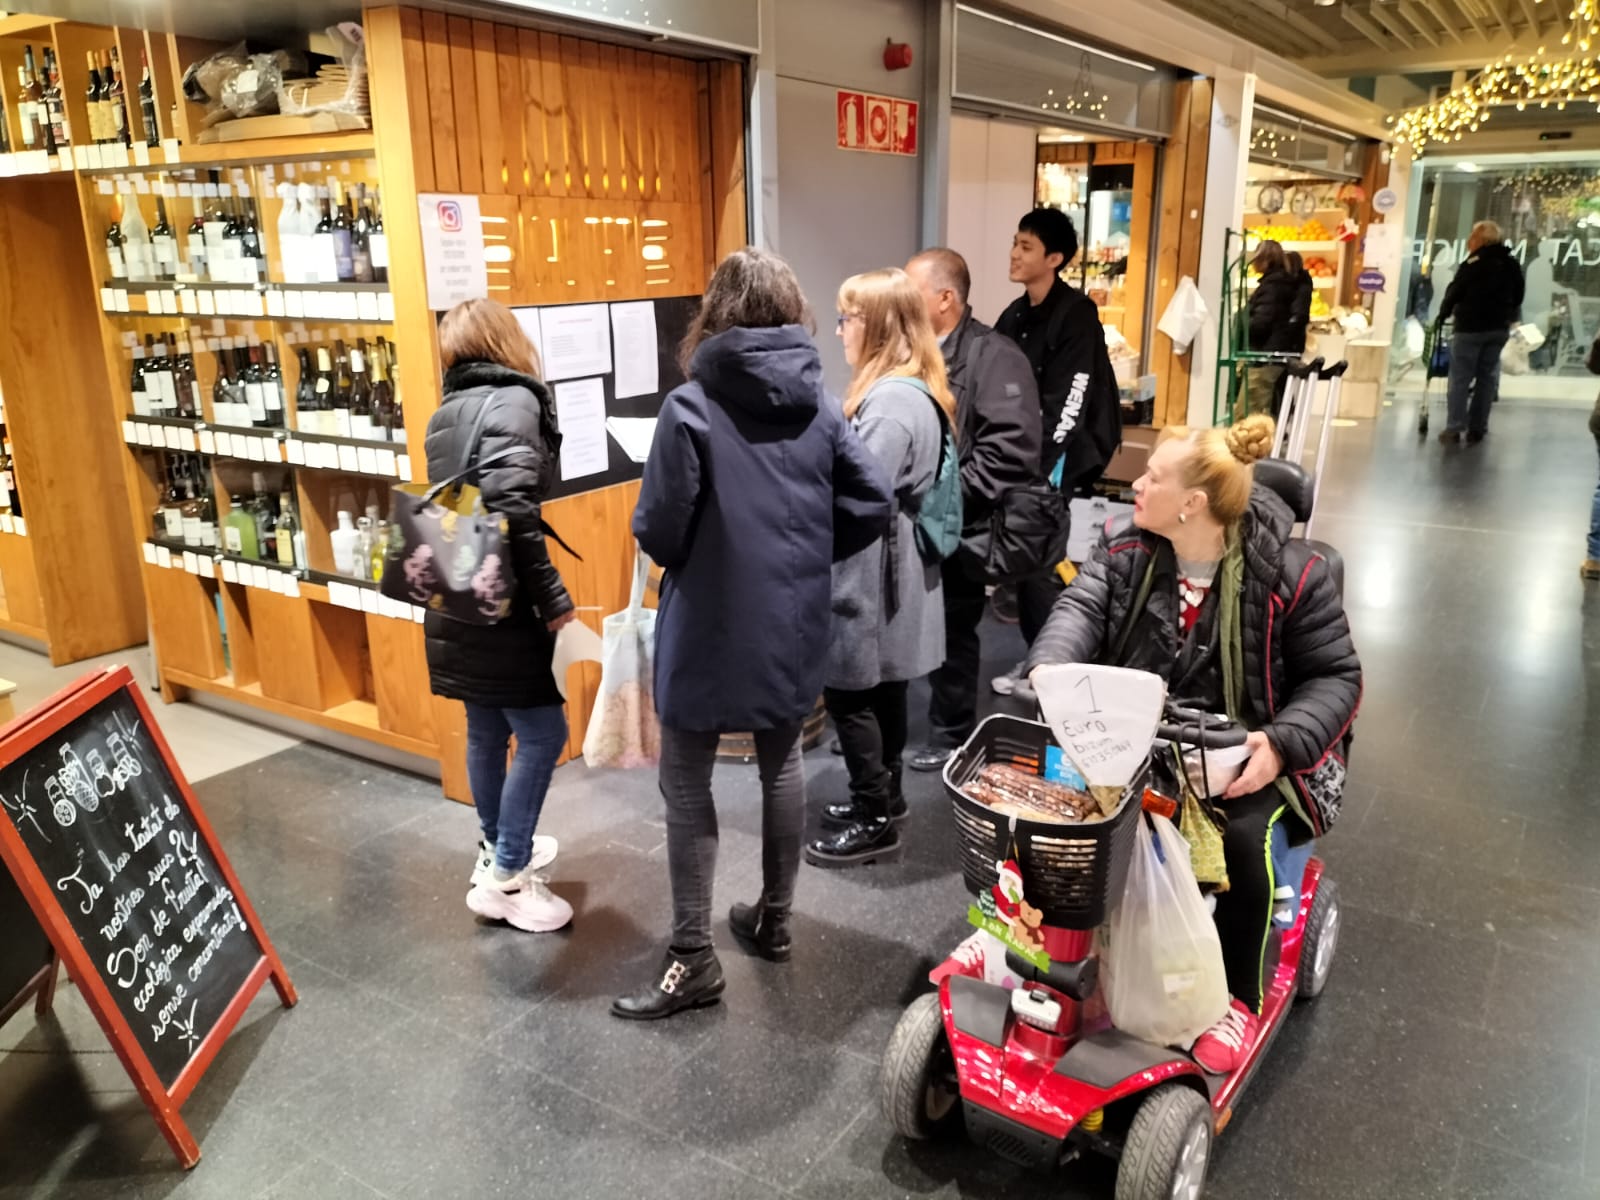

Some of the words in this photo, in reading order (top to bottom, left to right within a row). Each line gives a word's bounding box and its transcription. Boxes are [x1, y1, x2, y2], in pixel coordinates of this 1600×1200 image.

[1073, 674, 1102, 714] 1
[98, 849, 131, 884] has
[100, 888, 145, 942] nostres
[150, 908, 171, 937] de
[151, 983, 188, 1043] sense
